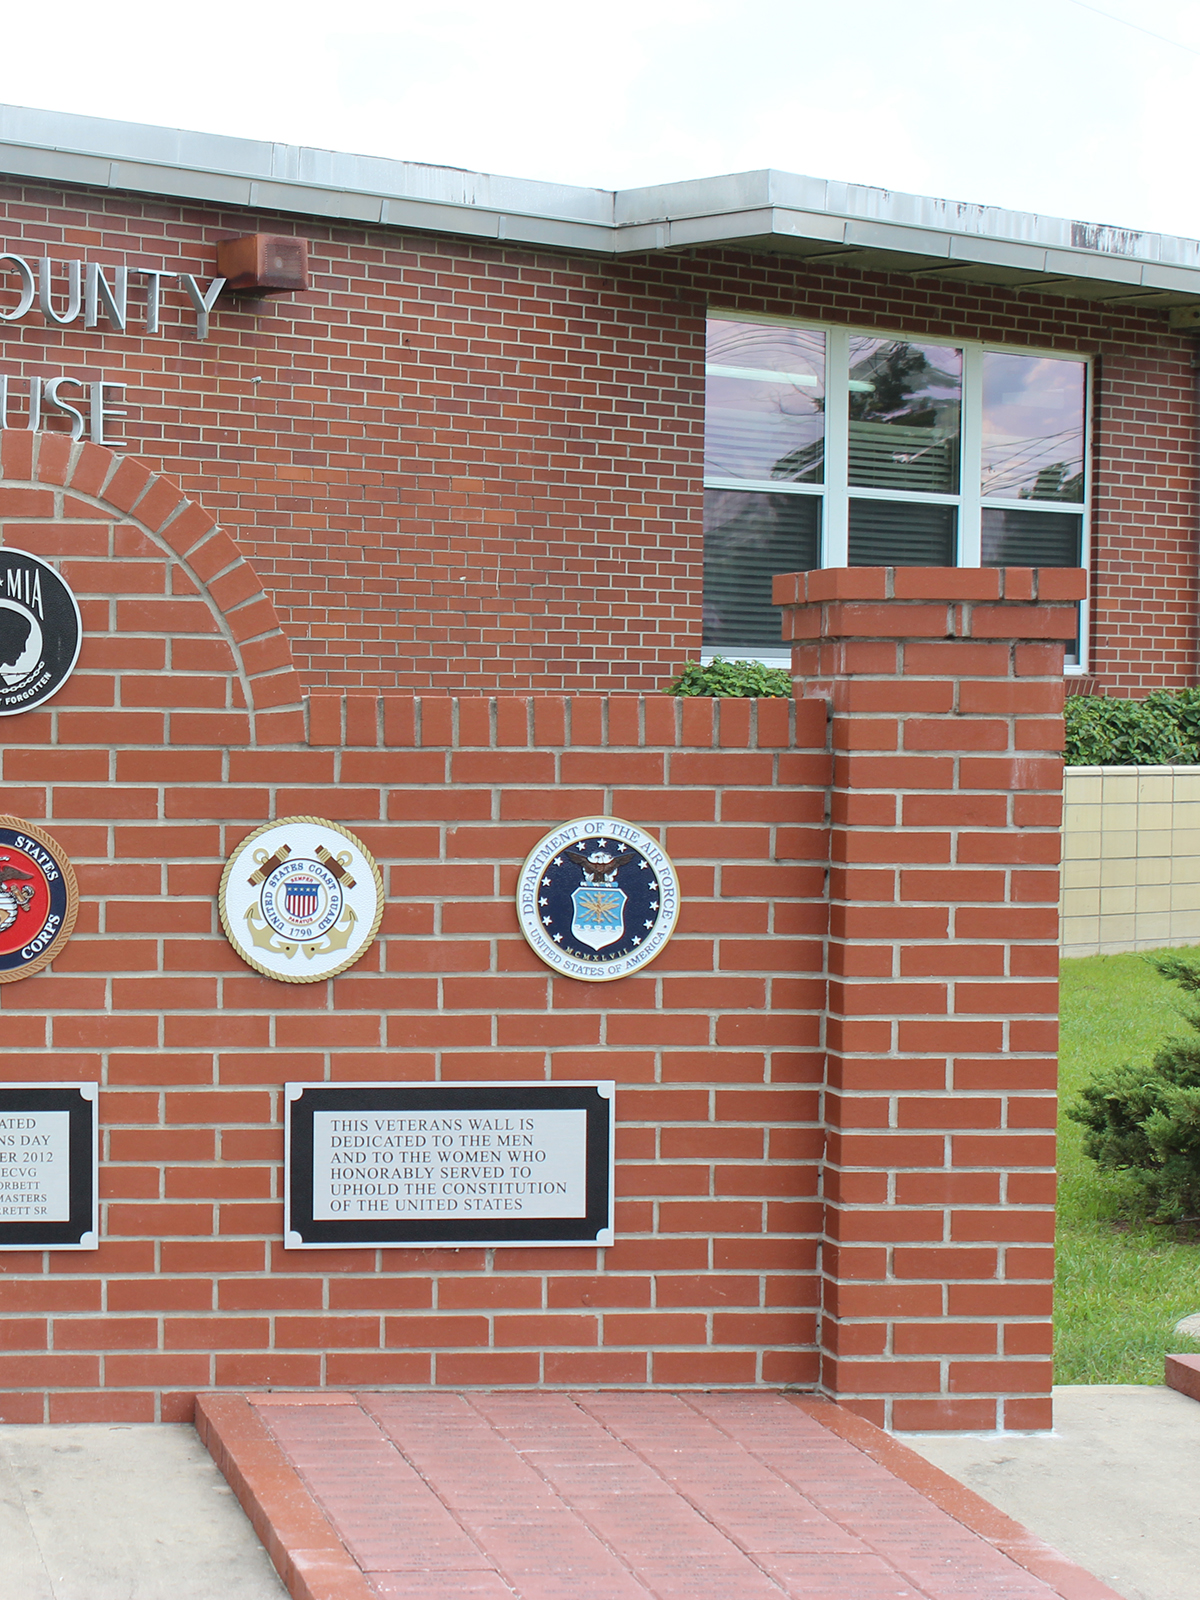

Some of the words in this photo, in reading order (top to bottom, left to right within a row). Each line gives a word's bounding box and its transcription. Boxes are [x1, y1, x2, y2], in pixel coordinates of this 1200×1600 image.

[7, 568, 44, 620] MIA
[5, 672, 52, 705] FORGOTTEN
[15, 836, 59, 882] STATES
[268, 863, 304, 888] STATES
[308, 864, 336, 890] COAST
[523, 826, 578, 915] DEPARTMENT
[584, 822, 605, 834] OF
[610, 823, 640, 844] THE
[640, 842, 664, 866] AIR
[658, 867, 675, 920] FORCE
[265, 891, 285, 930] UNITED
[318, 895, 339, 930] GUARD
[288, 916, 313, 924] PARATUS
[21, 914, 61, 960] CORPS
[289, 927, 312, 937] 1790
[530, 928, 562, 964] UNITED
[563, 960, 604, 976] STATES
[608, 963, 622, 974] OF
[625, 931, 665, 968] AMERICA
[565, 946, 629, 961] MCMXLVII
[330, 1119, 369, 1132] THIS
[374, 1118, 463, 1131] VETERANS
[468, 1118, 514, 1131] WALL
[519, 1118, 535, 1130] IS
[20, 1135, 51, 1146] DAY
[330, 1135, 426, 1148] DEDICATED
[431, 1135, 454, 1147] TO
[458, 1135, 492, 1147] THE
[496, 1134, 534, 1147] MEN
[23, 1152, 53, 1163] 2012
[330, 1151, 366, 1164] AND
[372, 1151, 394, 1164] TO
[399, 1151, 431, 1163] THE
[437, 1151, 501, 1163] WOMEN
[507, 1150, 546, 1162] WHO
[1, 1168, 37, 1178] ECVG
[330, 1167, 435, 1180] HONORABLY
[440, 1166, 505, 1179] SERVED
[509, 1166, 532, 1179] TO
[330, 1183, 399, 1196] UPHOLD
[404, 1183, 437, 1195] THE
[442, 1182, 568, 1195] CONSTITUTION
[34, 1206, 48, 1215] SR
[330, 1199, 351, 1212] OF
[356, 1199, 390, 1212] THE
[395, 1199, 458, 1211] UNITED
[463, 1198, 523, 1211] STATES
